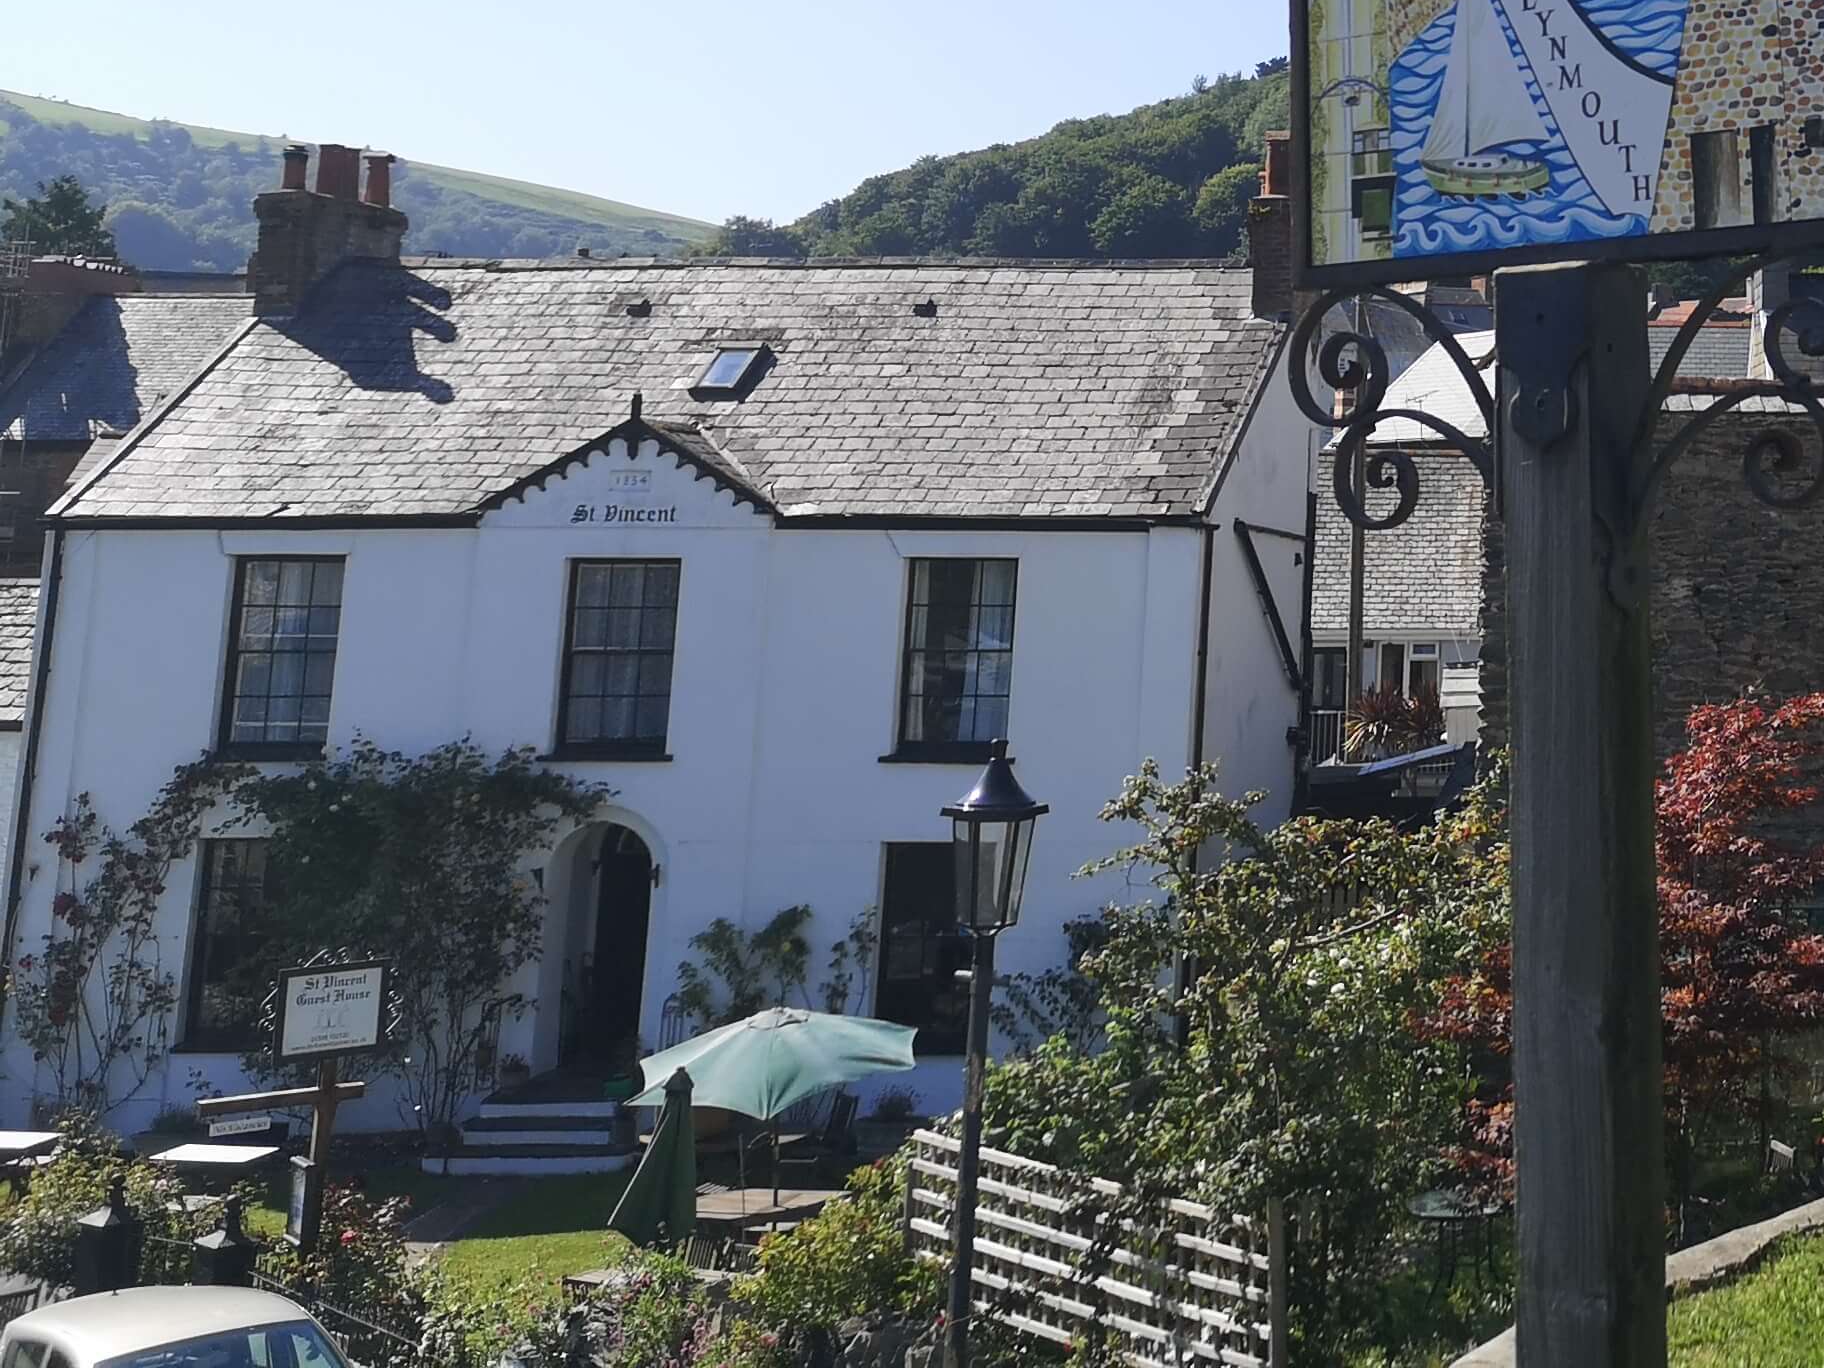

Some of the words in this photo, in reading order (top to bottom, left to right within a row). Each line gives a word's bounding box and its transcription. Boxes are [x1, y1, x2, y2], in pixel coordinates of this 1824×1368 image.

[570, 504, 595, 524] St
[603, 504, 677, 523] Vincent
[303, 977, 320, 991] St
[322, 974, 367, 990] Vincent
[295, 993, 331, 1007] Guest
[333, 989, 371, 1003] House
